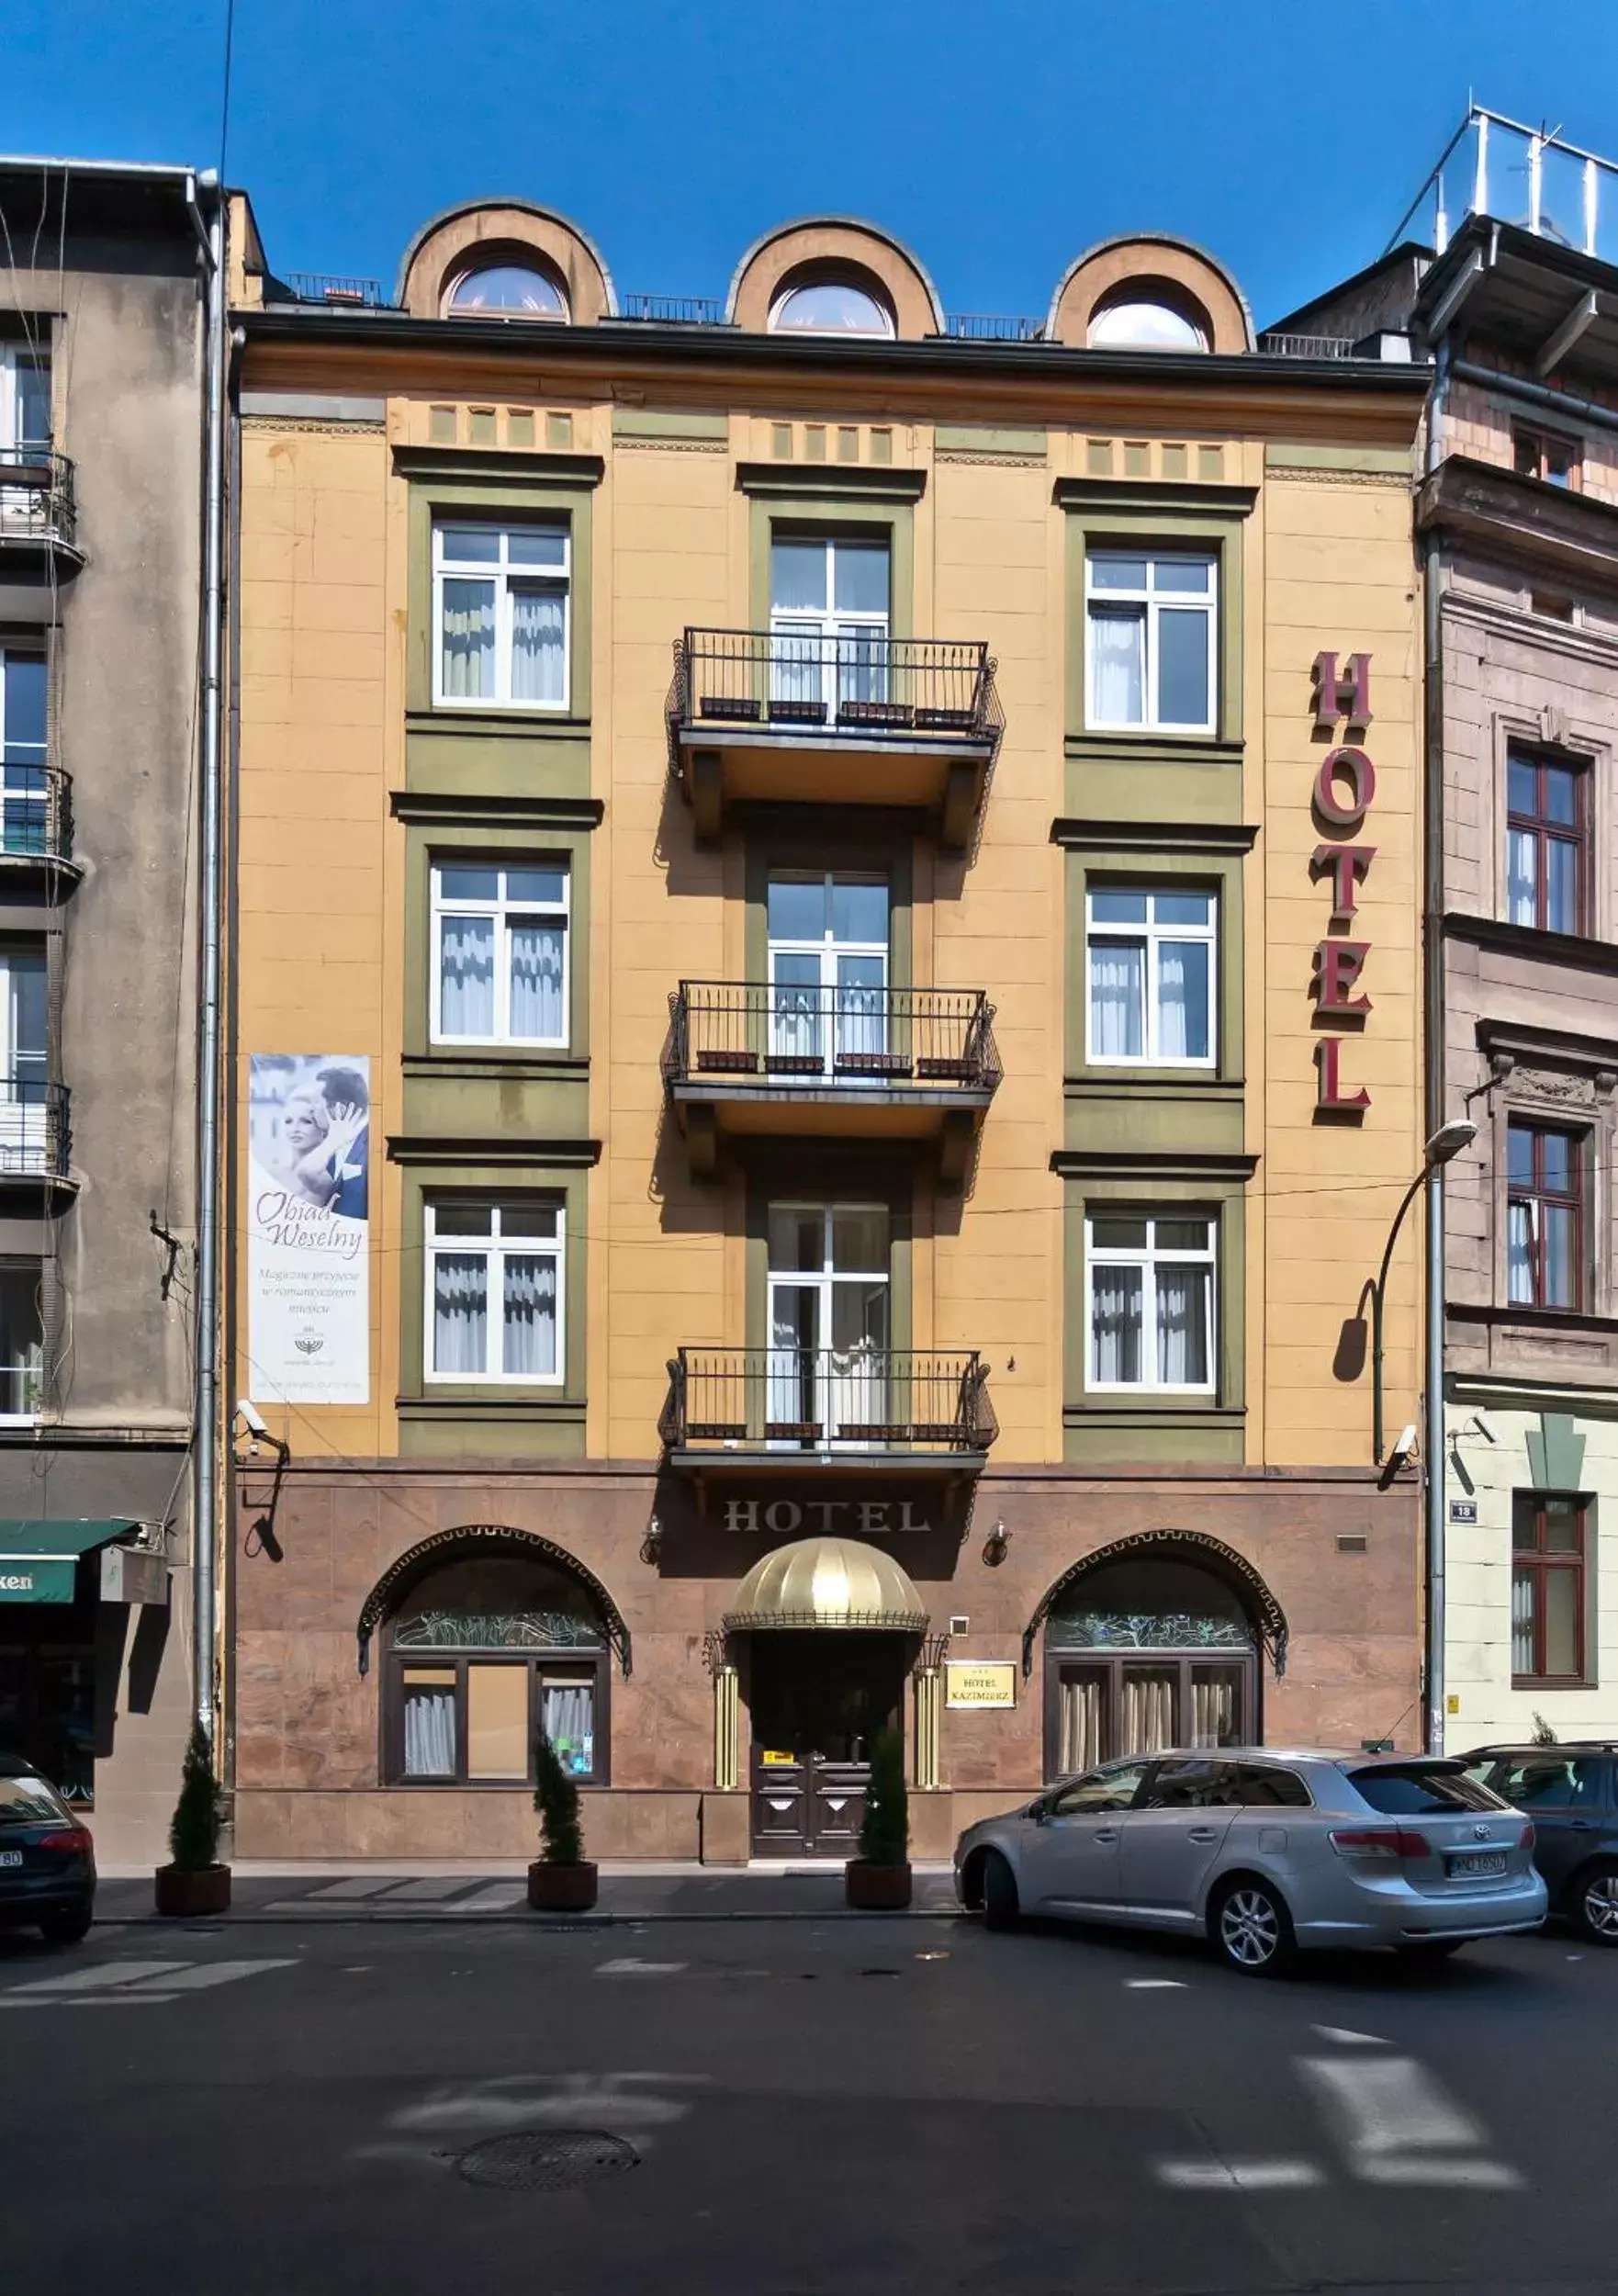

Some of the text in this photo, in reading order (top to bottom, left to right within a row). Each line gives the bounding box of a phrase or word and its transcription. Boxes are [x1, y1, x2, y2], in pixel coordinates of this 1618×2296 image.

[1312, 651, 1377, 1111] HOTEL
[256, 1192, 342, 1224] Obiad
[266, 1220, 362, 1260] Weselny
[724, 1500, 931, 1532] HOTEL
[951, 1691, 1010, 1701] KAZIMIERZ
[962, 1679, 998, 1688] HOTEL
